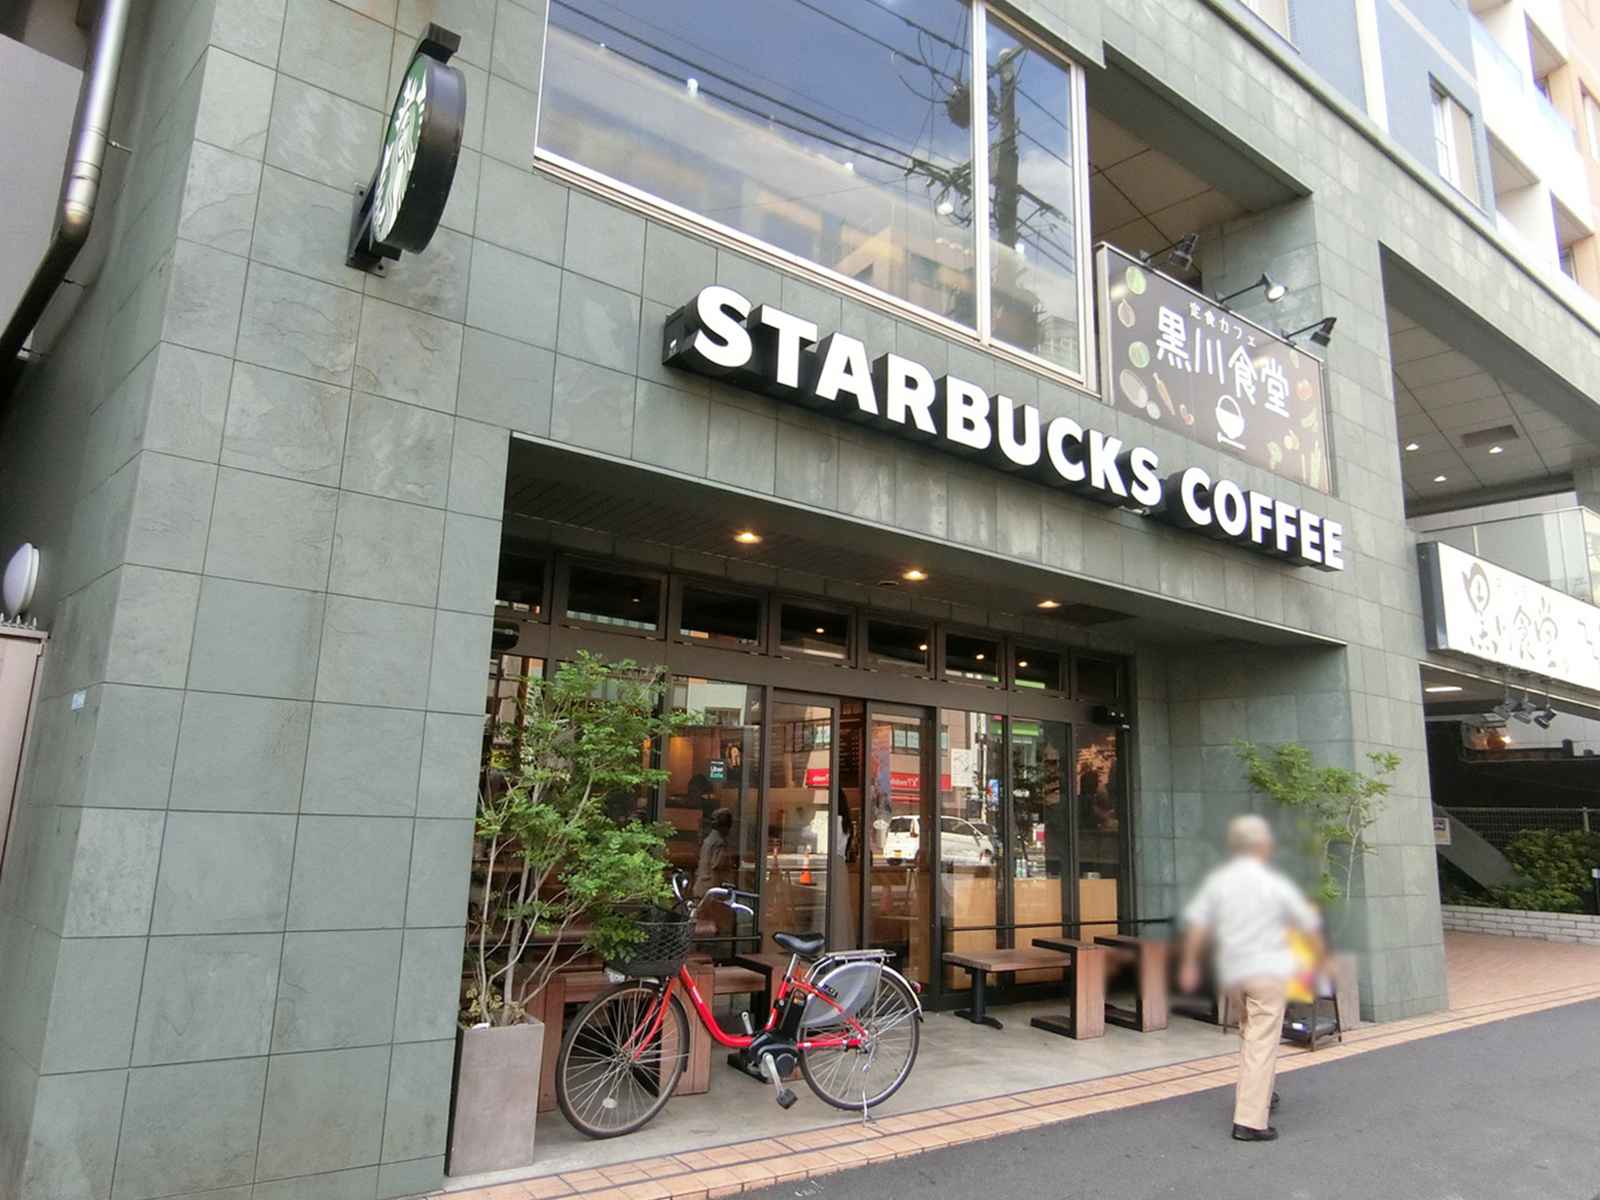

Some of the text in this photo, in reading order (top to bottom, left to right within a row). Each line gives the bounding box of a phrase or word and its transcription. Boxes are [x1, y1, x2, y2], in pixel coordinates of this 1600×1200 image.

[1155, 305, 1290, 419] 黒川食堂
[1189, 302, 1257, 348] 定食カフェ
[693, 285, 1345, 571] STARBUCKS COFFEE
